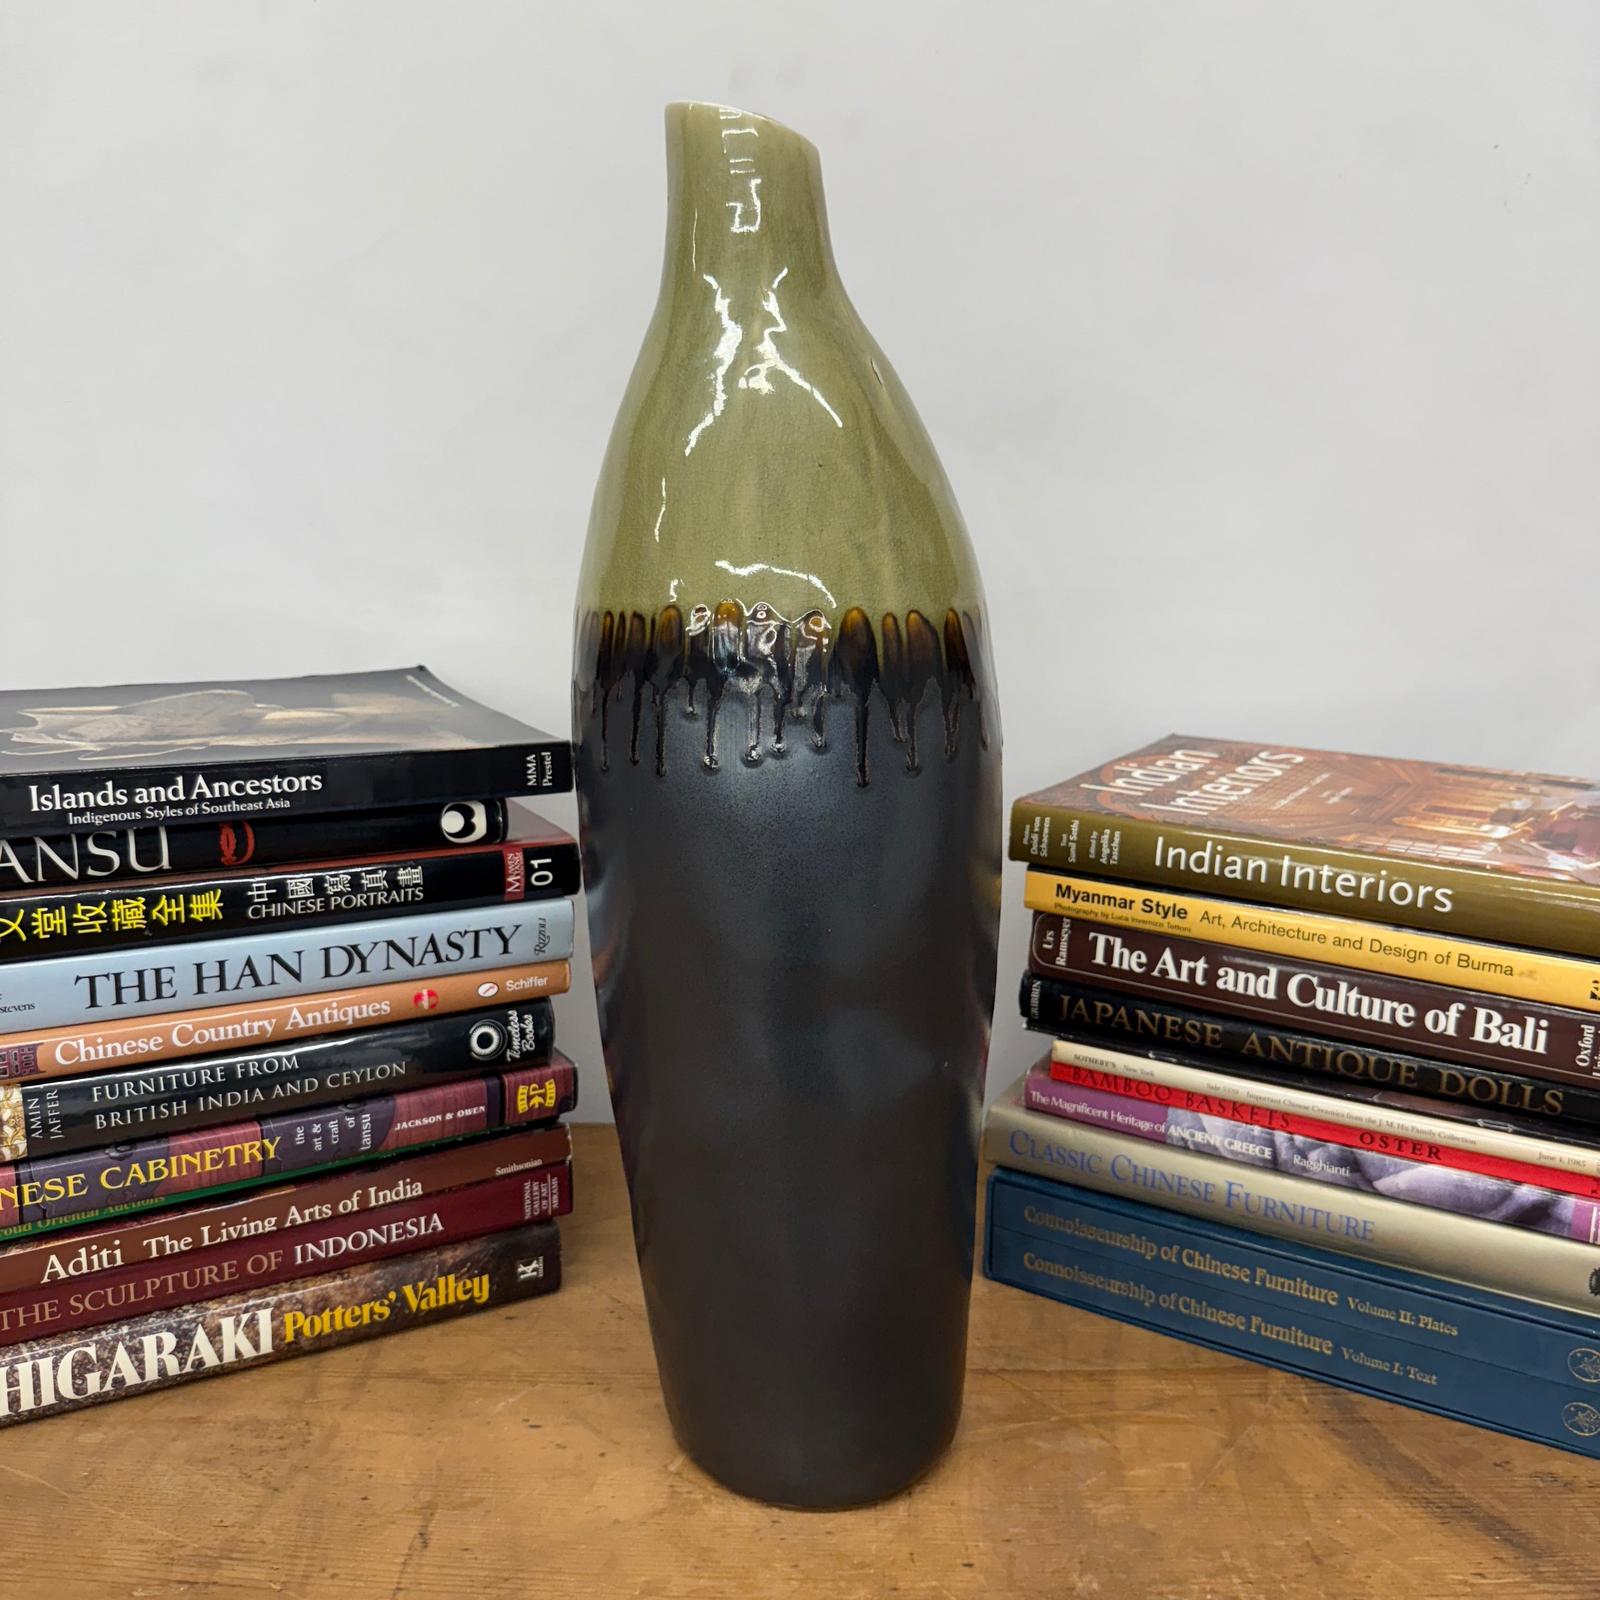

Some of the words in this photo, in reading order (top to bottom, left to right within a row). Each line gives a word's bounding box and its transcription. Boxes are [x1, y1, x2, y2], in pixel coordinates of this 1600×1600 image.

[527, 754, 537, 786] MMA
[542, 751, 552, 787] Prestel
[1080, 749, 1219, 796] Indian
[1138, 751, 1304, 816] Interiors
[29, 780, 128, 812] Islands
[135, 775, 186, 805] and
[190, 773, 323, 800] Ancestors
[68, 811, 142, 826] Indigenous
[146, 805, 183, 821] Styles
[186, 804, 202, 816] of
[202, 800, 263, 814] Southeast
[265, 798, 291, 809] Asia
[1109, 830, 1121, 865] Taschen
[530, 858, 553, 886] 01
[1154, 836, 1268, 884] Indian
[1280, 854, 1454, 913] Interiors
[248, 898, 326, 919] CHINESE
[330, 886, 424, 910] PORTRAITS
[1055, 883, 1136, 911] Myanmar
[1141, 898, 1189, 920] Style
[1200, 909, 1226, 928] Art,
[1231, 915, 1327, 945] Architecture
[1332, 935, 1364, 951] and
[1369, 938, 1428, 964] Design
[1434, 950, 1451, 965] of
[1457, 953, 1514, 977] Burma
[74, 966, 178, 1009] THE
[192, 950, 305, 996] HAN
[320, 924, 522, 979] DYNASTY
[505, 975, 548, 992] Schiffer
[1088, 931, 1148, 974] The
[1151, 947, 1209, 986] Art
[1215, 967, 1280, 1000] and
[1286, 973, 1417, 1028] Culture
[1424, 1002, 1465, 1036] of
[1469, 1006, 1549, 1054] Bali
[55, 1036, 163, 1066] Chinese
[171, 1018, 277, 1047] Country
[284, 1000, 391, 1031] Antiques
[506, 1009, 521, 1062] Timeless
[520, 1013, 536, 1051] Books
[1575, 1024, 1595, 1067] Oxford
[1059, 995, 1223, 1048] JAPANESE
[1241, 1031, 1418, 1088] ANTIQUE
[1438, 1070, 1564, 1116] DOLLS
[92, 1066, 226, 1102] FURNITURE
[235, 1055, 299, 1080] FROM
[95, 1100, 189, 1130] BRITISH
[199, 1090, 264, 1113] INDIA
[272, 1077, 319, 1100] AND
[327, 1061, 407, 1088] CEYLON
[1072, 1066, 1172, 1101] BAMBOO
[1186, 1092, 1289, 1129] BASKETS
[27, 1097, 43, 1139] AMIN
[47, 1088, 65, 1140] JAFFER
[295, 1125, 305, 1145] the
[312, 1123, 322, 1134] &
[328, 1119, 339, 1144] craft
[345, 1116, 356, 1128] of
[394, 1114, 442, 1131] JACKSON
[445, 1112, 455, 1121] &
[457, 1105, 486, 1119] OWEN
[1030, 1091, 1050, 1106] The
[1050, 1095, 1110, 1121] Magnificent
[1110, 1110, 1153, 1131] Heritage
[1154, 1121, 1167, 1133] of
[1167, 1124, 1223, 1146] ANCIENT
[1223, 1138, 1272, 1160] GREECE
[312, 1137, 322, 1151] art
[1359, 1132, 1442, 1160] OSTER
[0, 1173, 88, 1210] NESE
[100, 1136, 281, 1190] CABINETRY
[495, 1158, 543, 1176] Smithsonian
[1292, 1154, 1351, 1177] Ragghianti
[40, 1239, 125, 1284] Aditi
[143, 1234, 193, 1258] The
[201, 1216, 277, 1248] Living
[283, 1203, 332, 1228] Arts
[338, 1190, 362, 1213] of
[368, 1178, 423, 1207] India
[0, 1299, 62, 1331] THE
[70, 1260, 240, 1316] SCULPTURE
[246, 1250, 284, 1275] OF
[294, 1213, 444, 1265] INDONESIA
[1024, 1206, 1157, 1259] Connoisseurship
[1160, 1244, 1180, 1263] of
[1182, 1248, 1249, 1283] Chinese
[1254, 1267, 1339, 1307] Furniture
[1347, 1296, 1396, 1321] Volume
[1399, 1309, 1415, 1326] II:
[1418, 1314, 1459, 1337] Plates
[402, 1273, 490, 1313] Valley
[1024, 1252, 1156, 1307] Connoisseurship
[1159, 1291, 1178, 1310] of
[1178, 1296, 1246, 1331] Chinese
[1249, 1315, 1333, 1356] Furniture
[1340, 1346, 1390, 1372] Volume
[1407, 1366, 1438, 1386] Text
